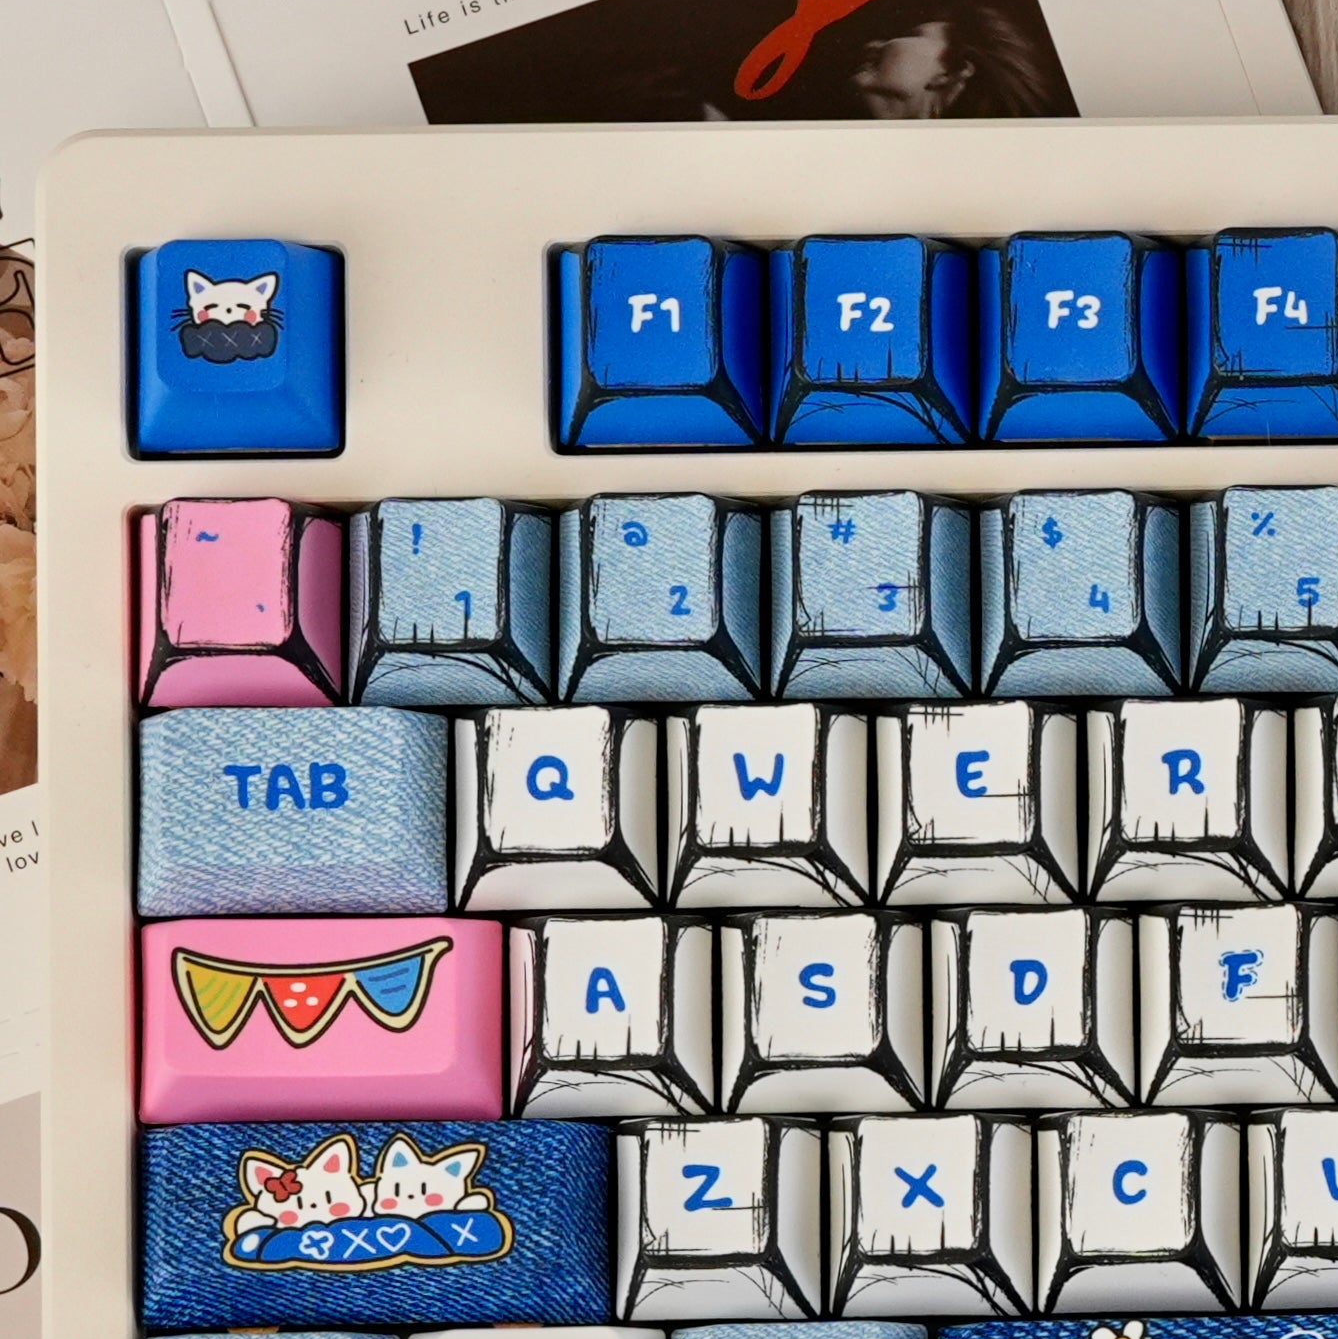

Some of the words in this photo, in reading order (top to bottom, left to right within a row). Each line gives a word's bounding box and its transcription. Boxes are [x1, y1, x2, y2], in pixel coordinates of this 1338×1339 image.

[404, 8, 450, 35] Life
[460, 0, 481, 16] is
[628, 293, 681, 333] F1
[837, 292, 894, 332] F2
[1045, 290, 1101, 329] F3
[1253, 286, 1309, 325] F4
[454, 590, 471, 617] 1
[670, 585, 691, 616] 2
[877, 583, 902, 612] 3
[1089, 584, 1110, 613] 4
[1296, 577, 1320, 608] 5
[223, 762, 349, 811] TAB
[526, 755, 575, 801] Q
[733, 753, 785, 801] W
[955, 750, 990, 799] E
[1162, 749, 1206, 795] R
[6, 851, 38, 872] lov
[585, 967, 626, 1014] A
[799, 962, 837, 1009] S
[1010, 959, 1048, 1005] D
[1220, 948, 1264, 1002] F
[682, 1164, 734, 1212] Z
[895, 1164, 945, 1208] X
[1113, 1159, 1149, 1205] C
